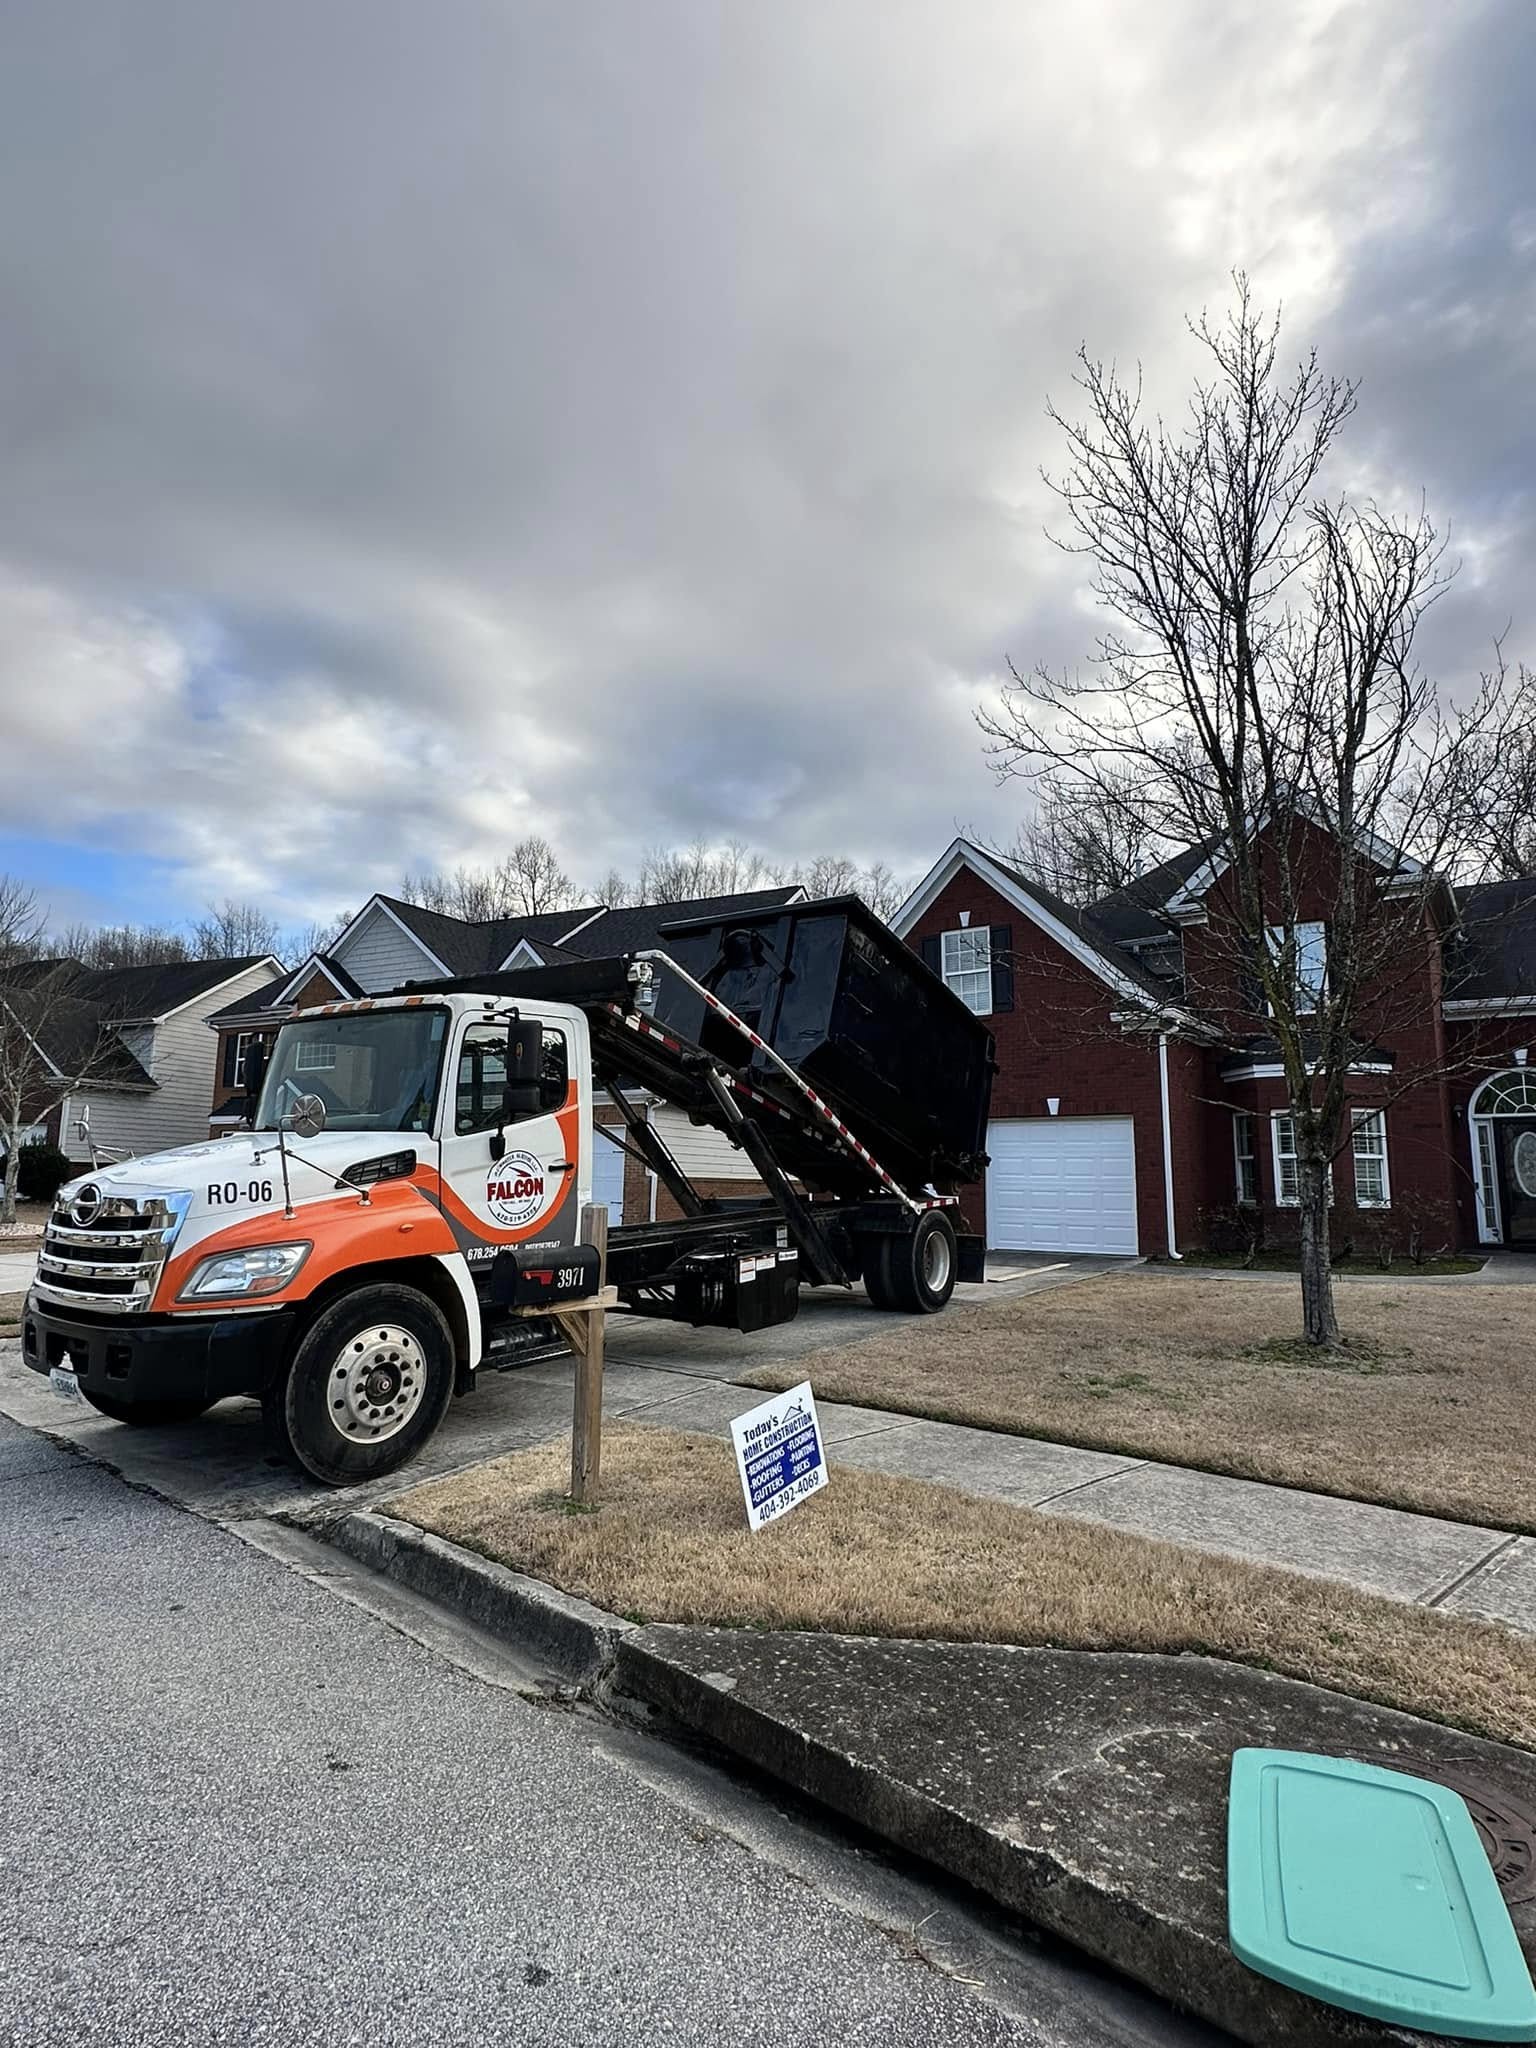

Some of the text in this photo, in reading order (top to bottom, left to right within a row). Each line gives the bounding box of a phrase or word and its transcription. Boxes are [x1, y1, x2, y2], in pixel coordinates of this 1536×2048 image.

[207, 1180, 273, 1205] RO-06
[487, 1177, 544, 1202] FALCON
[557, 1267, 585, 1289] 3971
[743, 1415, 780, 1443] Today's
[743, 1412, 813, 1461] HOME CONSTRUCTION
[760, 1470, 819, 1522] 404-392-4069
